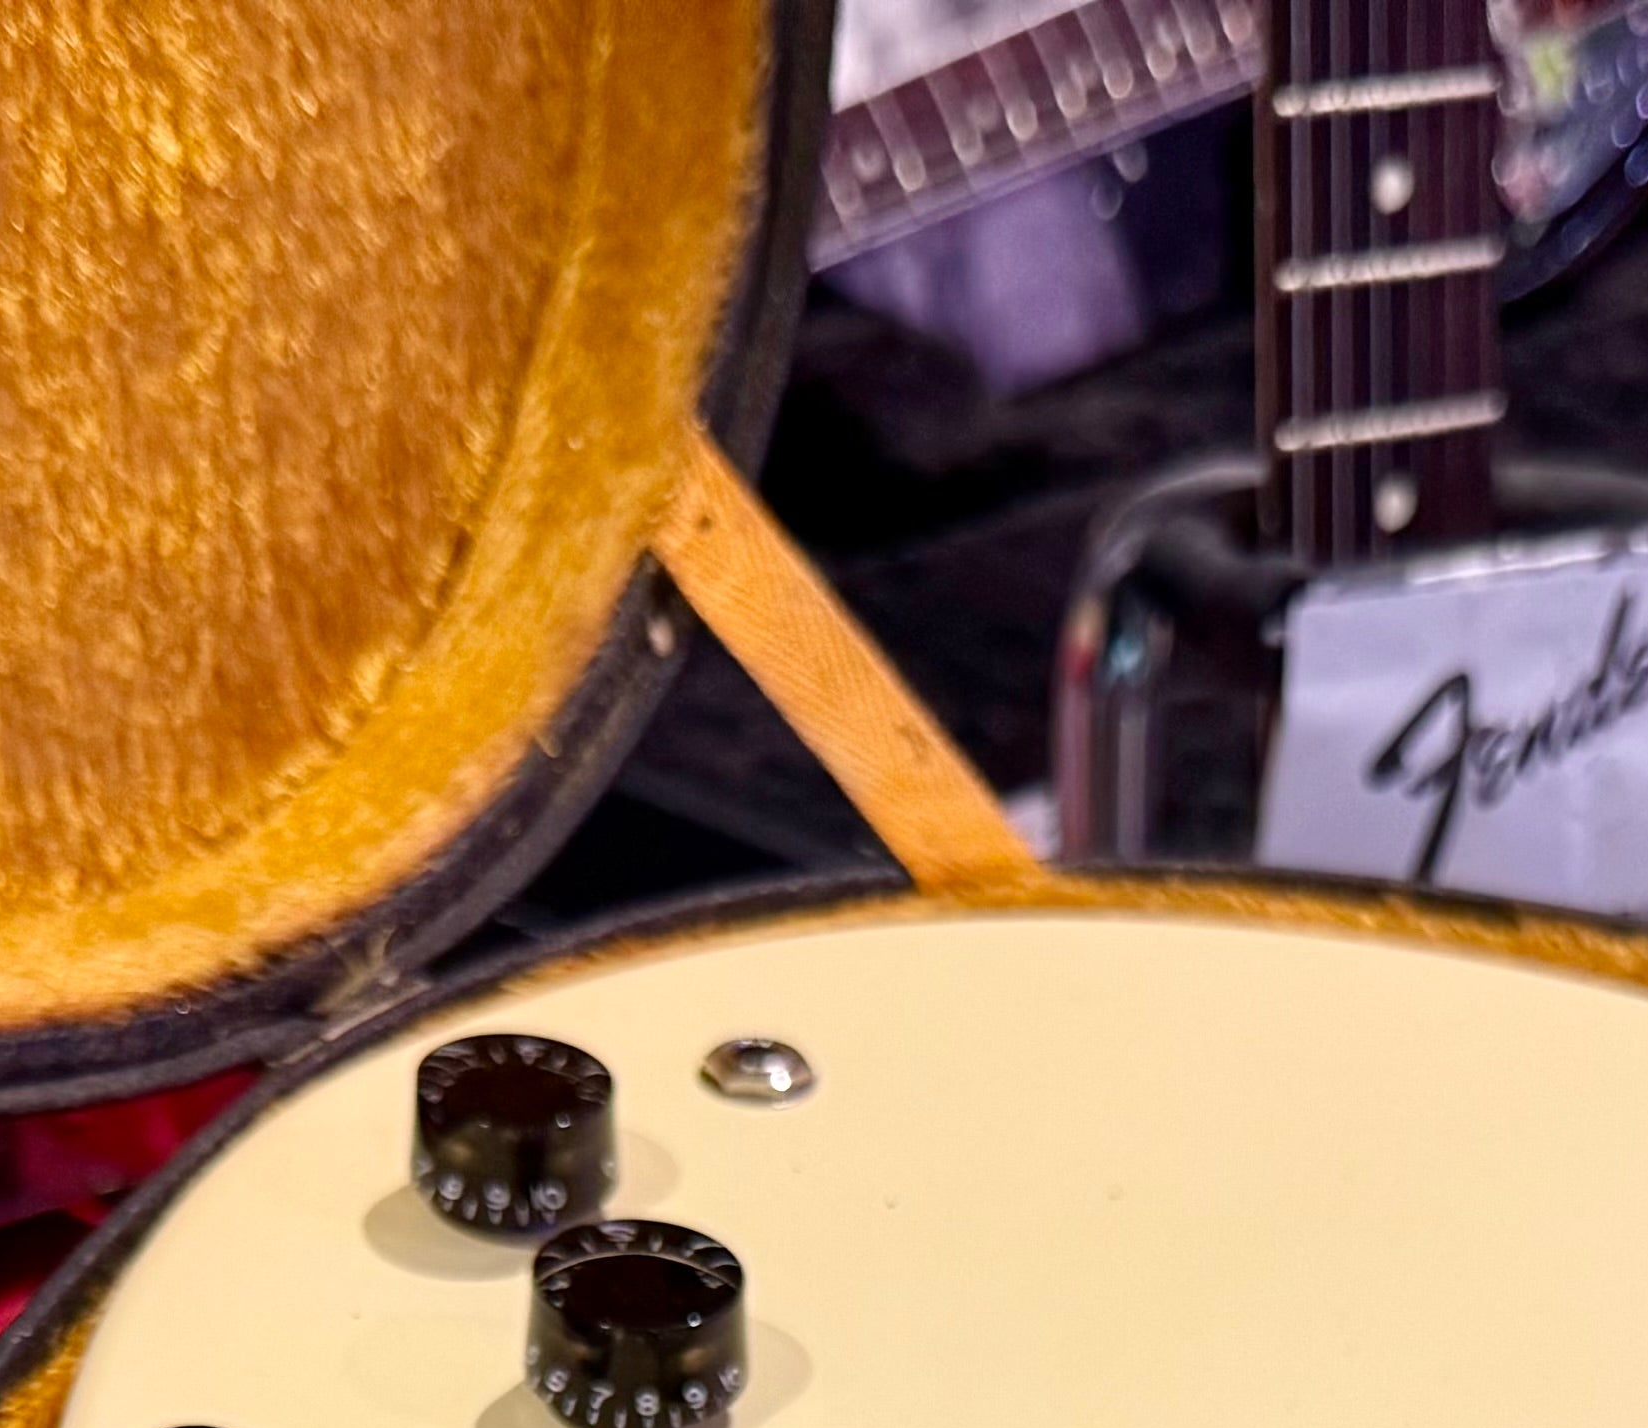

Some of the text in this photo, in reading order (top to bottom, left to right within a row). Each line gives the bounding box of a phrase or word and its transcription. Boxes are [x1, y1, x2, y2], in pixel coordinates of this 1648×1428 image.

[589, 1380, 614, 1410] 7
[635, 1387, 660, 1416] 8
[682, 1380, 707, 1409] 9
